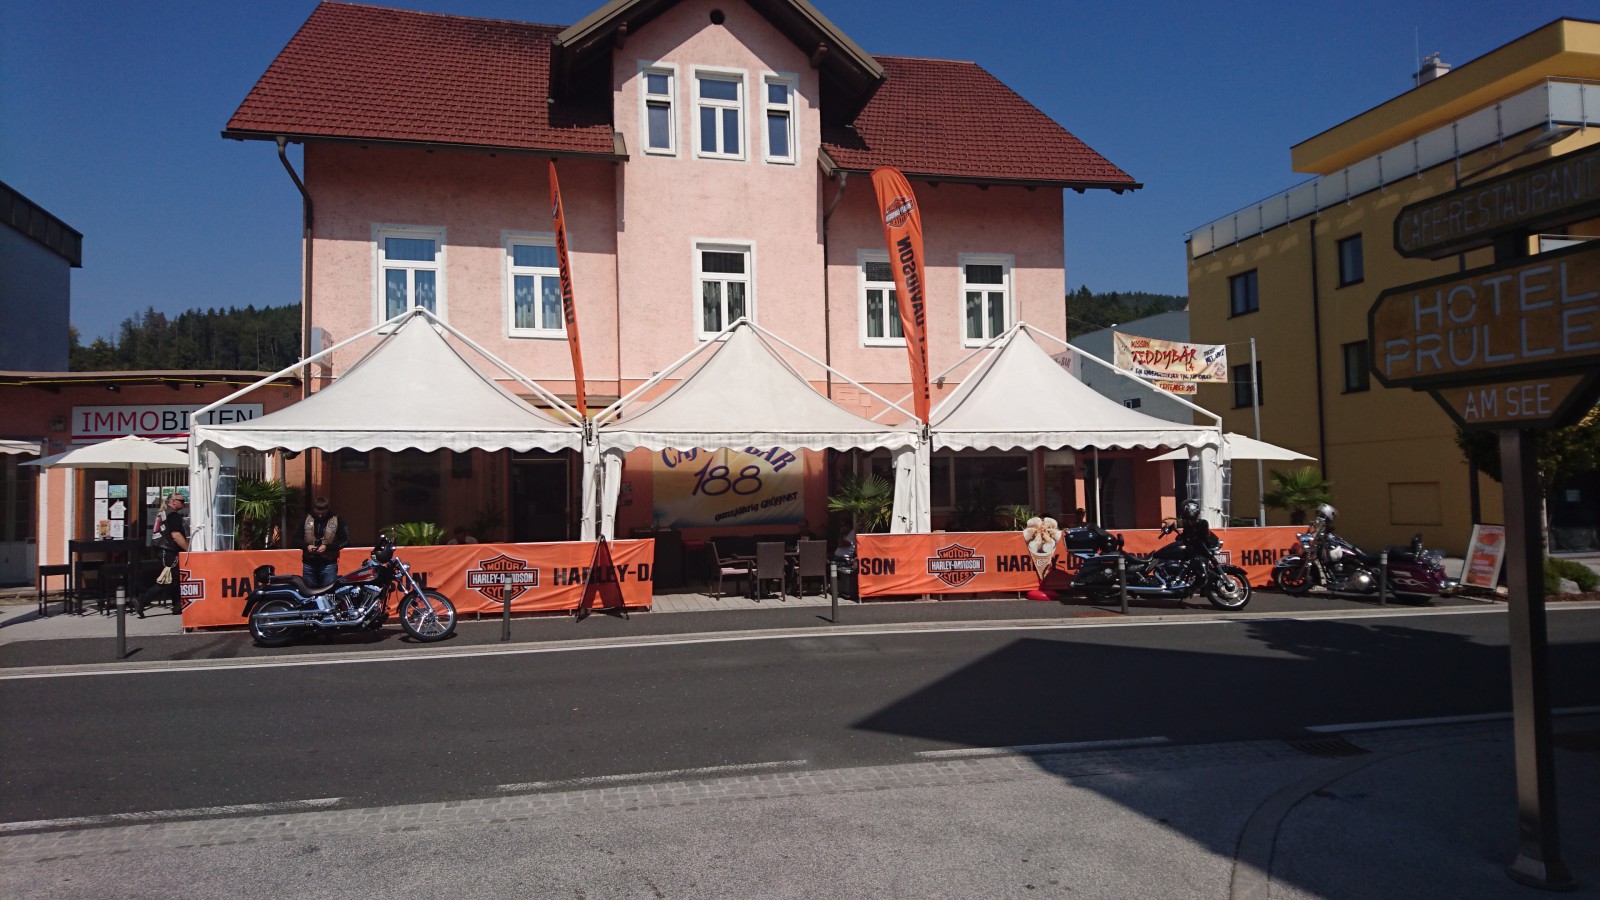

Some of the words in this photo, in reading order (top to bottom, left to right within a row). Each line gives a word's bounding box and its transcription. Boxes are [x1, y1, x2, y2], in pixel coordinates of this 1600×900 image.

[1413, 261, 1600, 331] HOTEL
[1131, 345, 1197, 369] TEDDYBÄR
[1464, 389, 1498, 419] AM
[1506, 383, 1551, 416] SEE
[691, 455, 763, 497] 188
[943, 547, 969, 558] MOTOR
[487, 560, 520, 571] MOTOR
[931, 559, 981, 571] HARLEY-DAVIDSON
[943, 571, 969, 584] CYCLES
